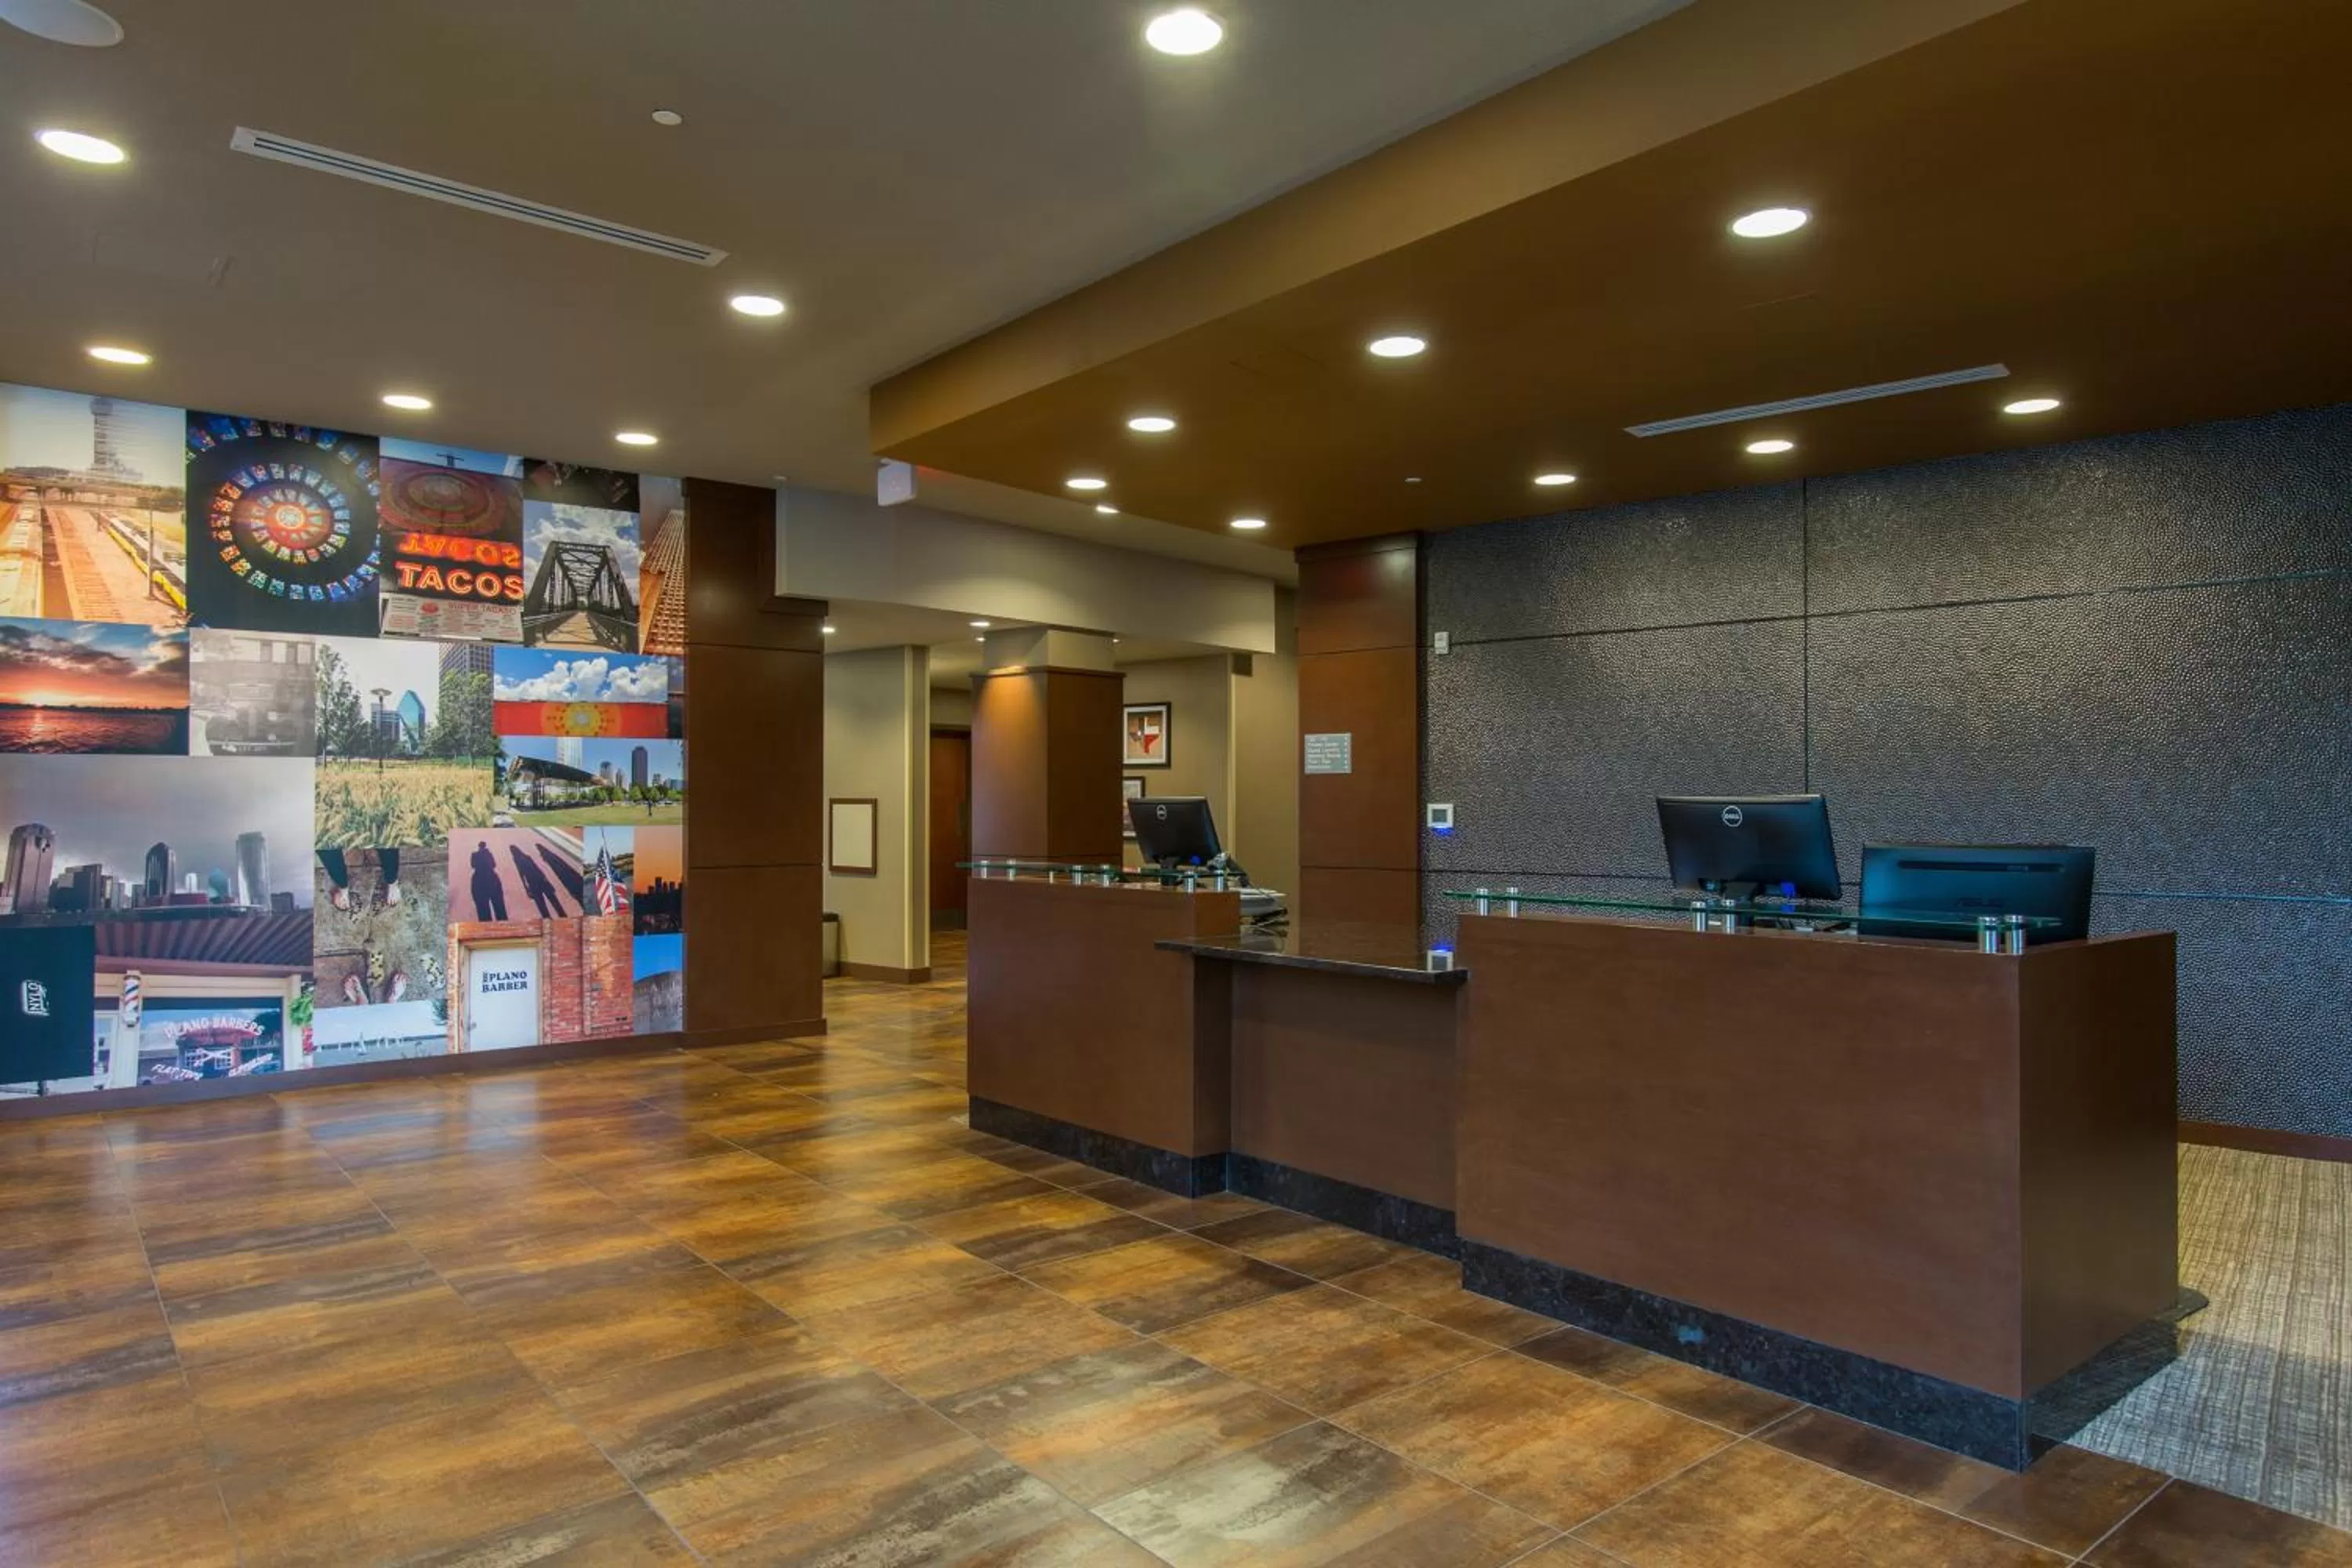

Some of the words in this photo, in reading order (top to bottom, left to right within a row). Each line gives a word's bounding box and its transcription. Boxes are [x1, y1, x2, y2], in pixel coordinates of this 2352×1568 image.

[395, 561, 524, 601] TACOS
[489, 971, 528, 982] PLANO
[27, 982, 41, 1011] NYLO
[482, 981, 528, 993] BARBER
[212, 1016, 265, 1036] BARBERS
